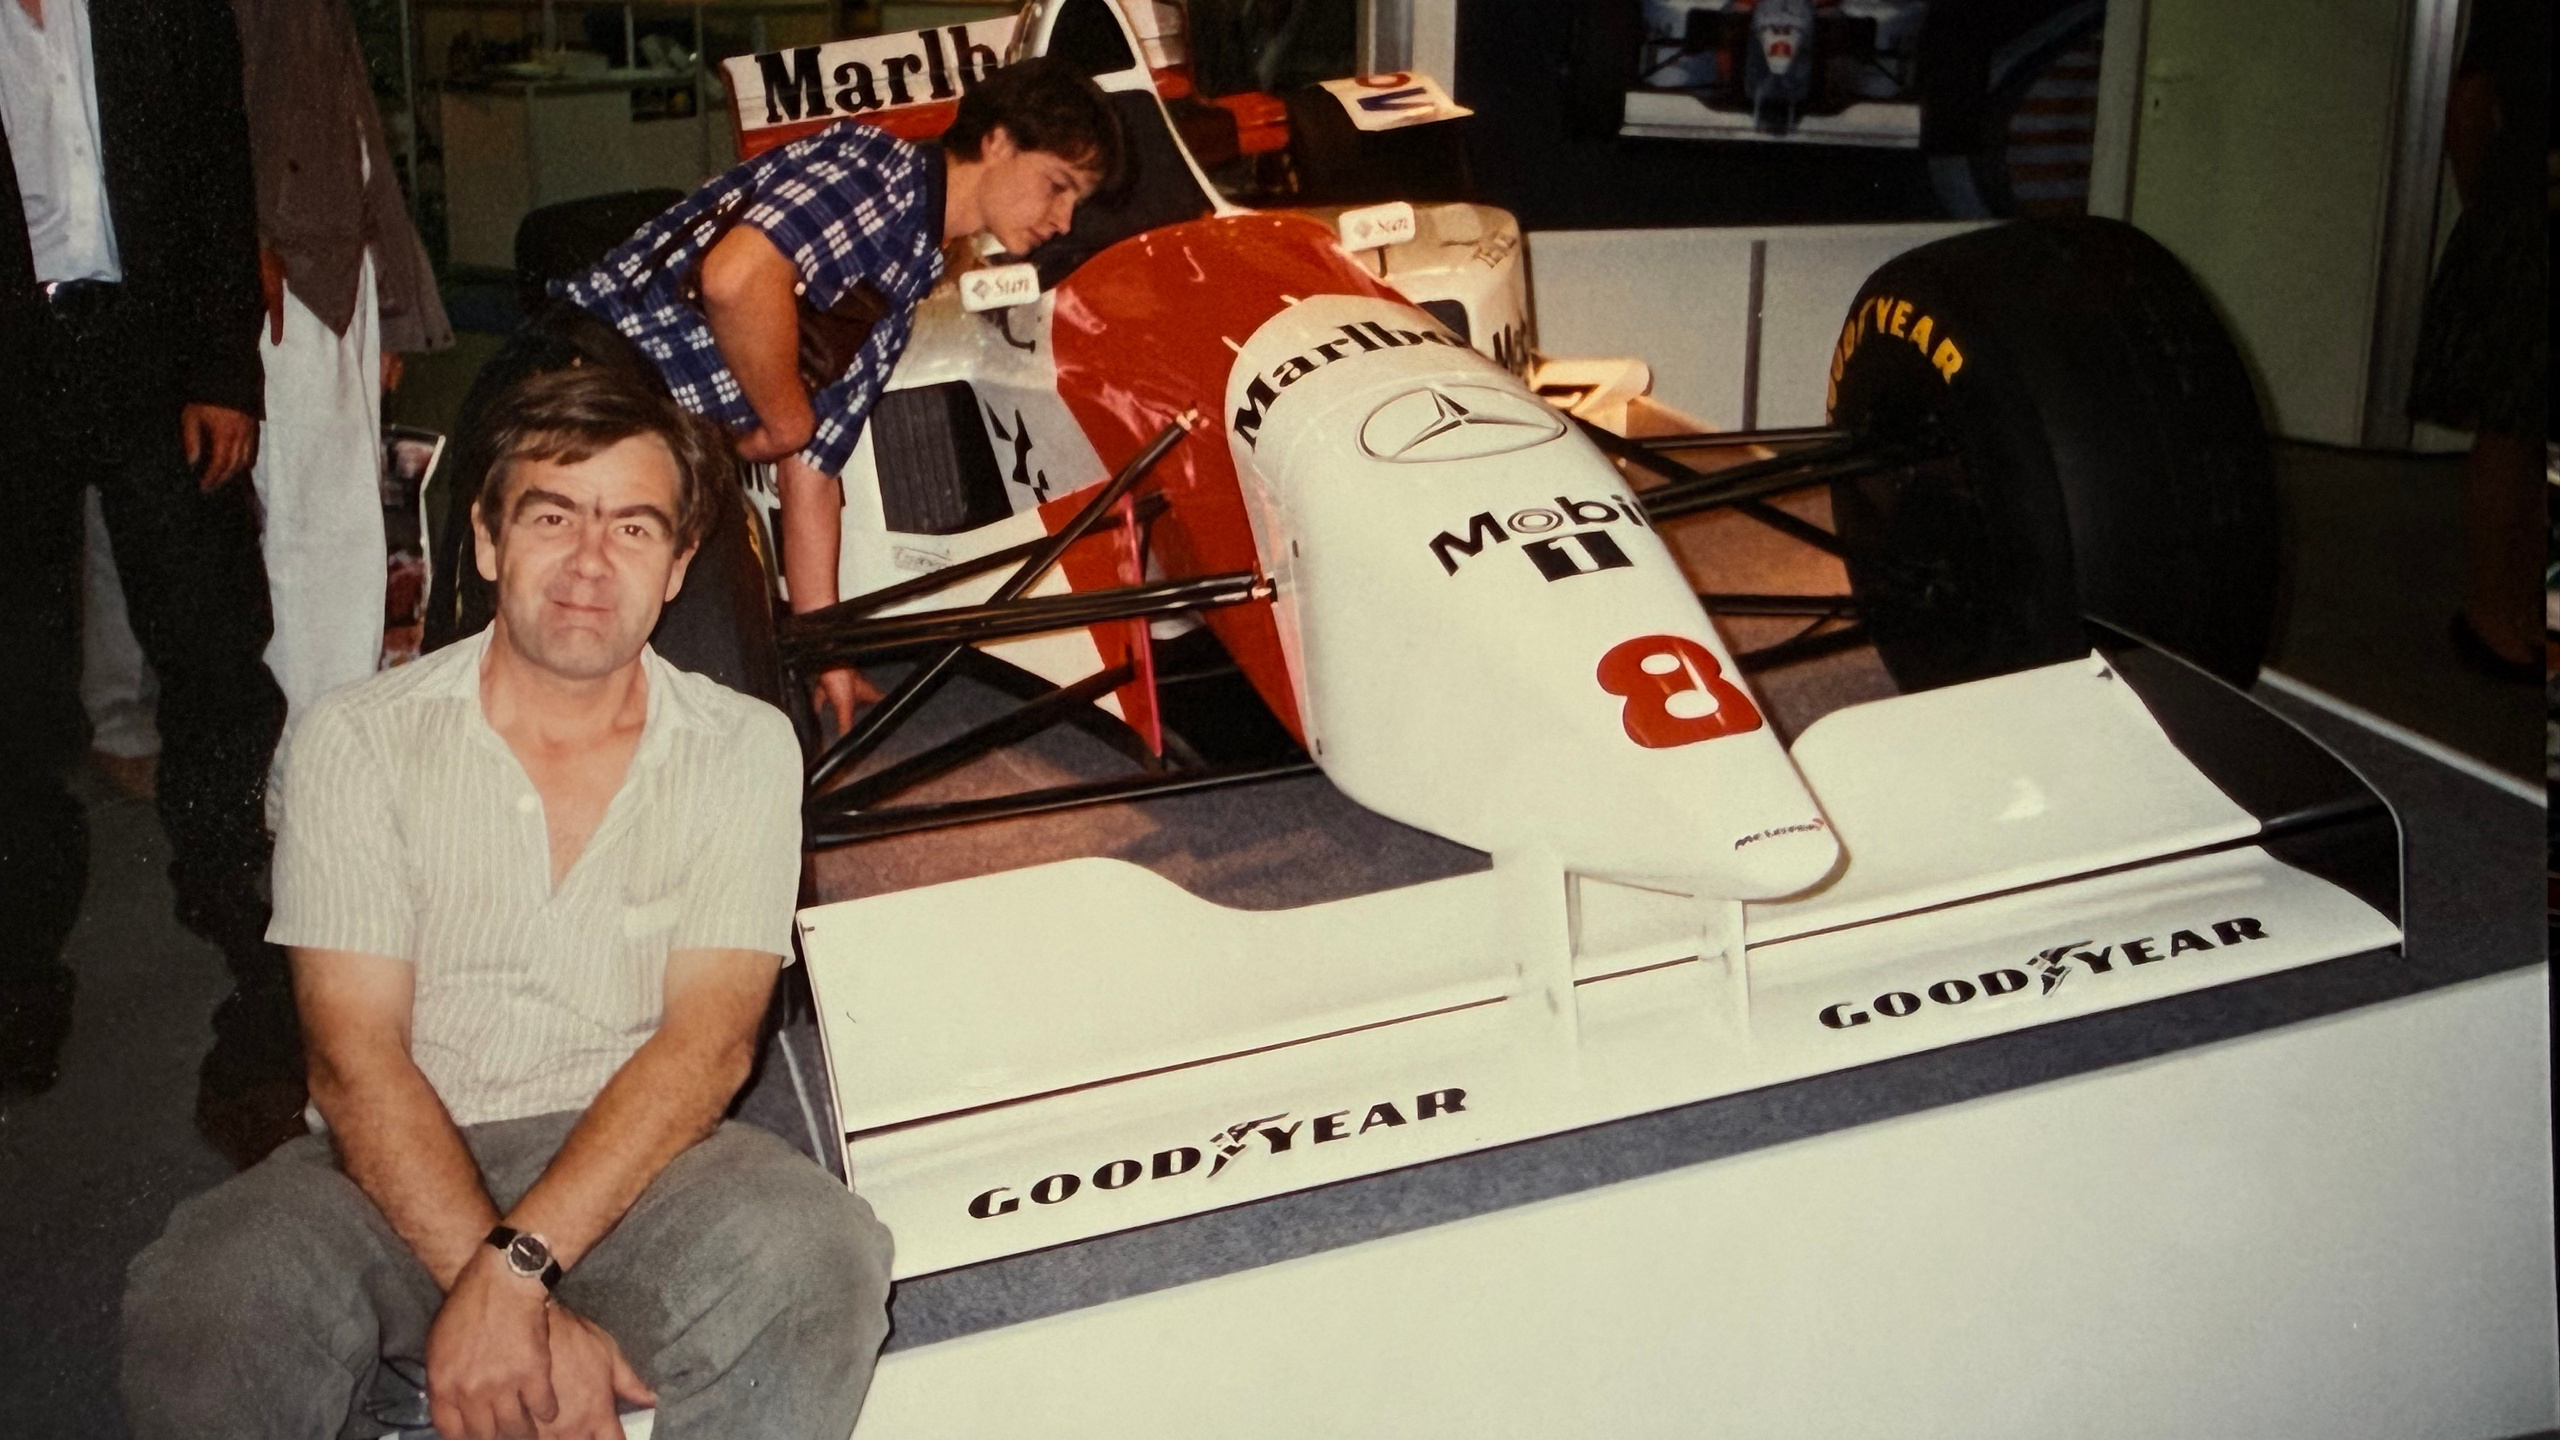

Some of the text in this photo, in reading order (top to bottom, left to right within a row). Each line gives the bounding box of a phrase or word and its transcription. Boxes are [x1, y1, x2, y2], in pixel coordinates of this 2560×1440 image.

[995, 277, 1031, 295] Sun
[1597, 634, 1763, 749] 8
[1818, 917, 2269, 1030] GOODYEAR
[967, 1087, 1467, 1219] GOODYEAR
